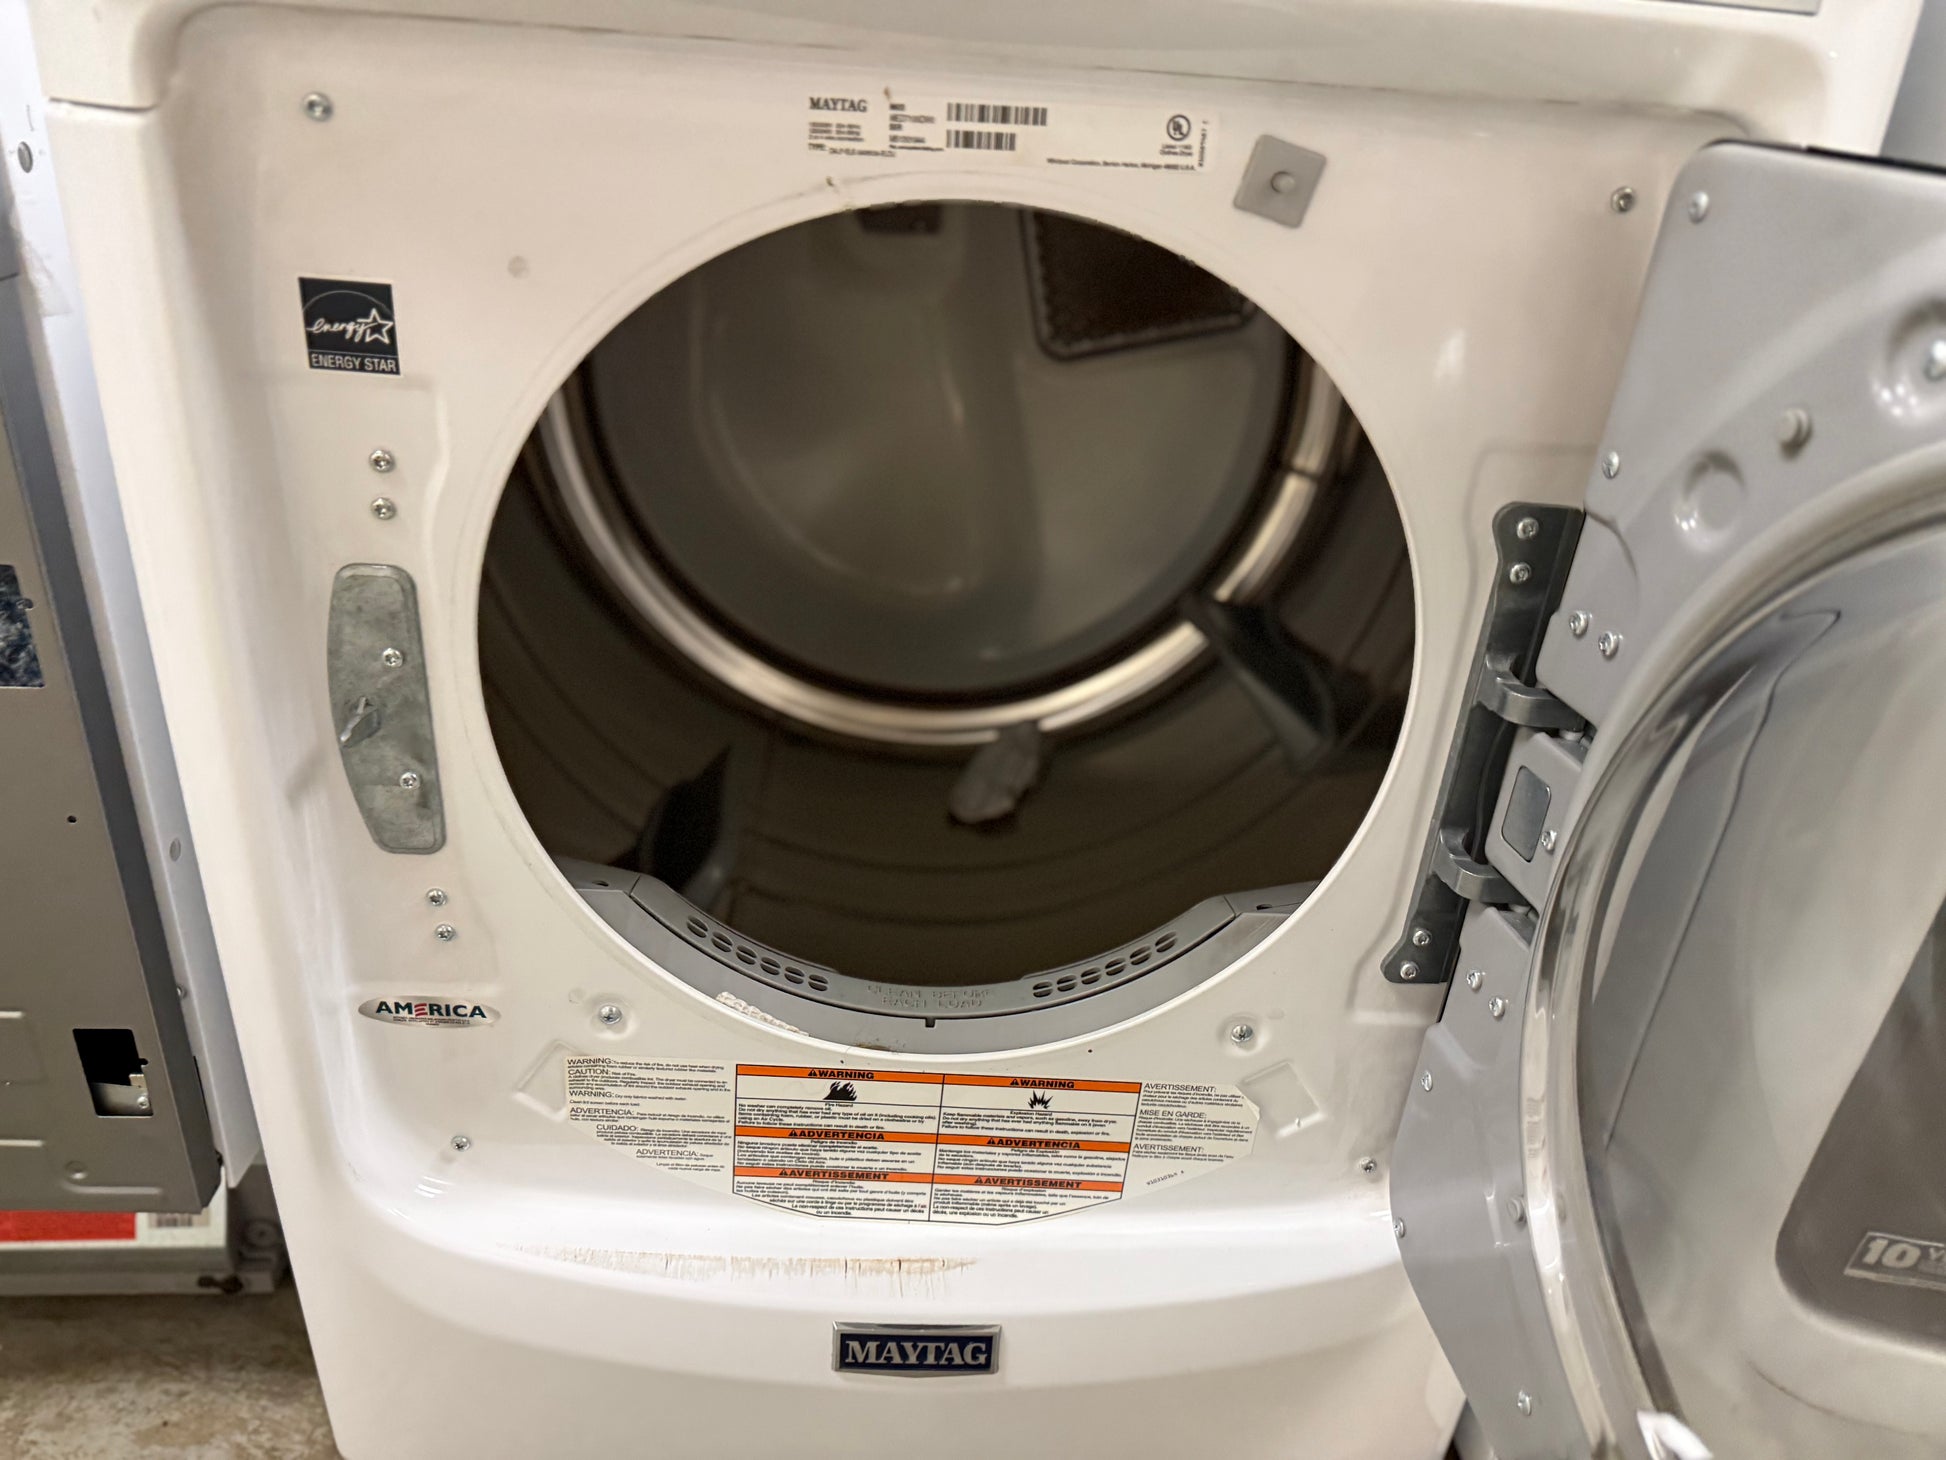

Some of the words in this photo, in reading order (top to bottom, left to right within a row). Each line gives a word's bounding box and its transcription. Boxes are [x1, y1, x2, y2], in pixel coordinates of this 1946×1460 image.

[808, 97, 868, 112] MAYTAG
[311, 353, 362, 370] ENERGY
[364, 358, 396, 372] STAR
[376, 1001, 487, 1018] AMERICA
[818, 1070, 874, 1080] WARNING
[1020, 1079, 1075, 1089] WARNING
[1144, 1083, 1217, 1092] AVERTISSEMENT:
[569, 1107, 634, 1116] ADVERTENCIA:
[799, 1130, 884, 1140] ADVERTENCIA
[997, 1139, 1080, 1149] ADVERTENCIA
[1133, 1144, 1204, 1153] AVERTISSEMENT:
[636, 1149, 699, 1157] ADVERTENCIA:
[789, 1170, 889, 1180] AVERTISSEMENT
[984, 1178, 1083, 1188] AVERTISSEMENT
[1862, 1238, 1922, 1268] 10
[844, 1340, 988, 1366] MAYTAG
